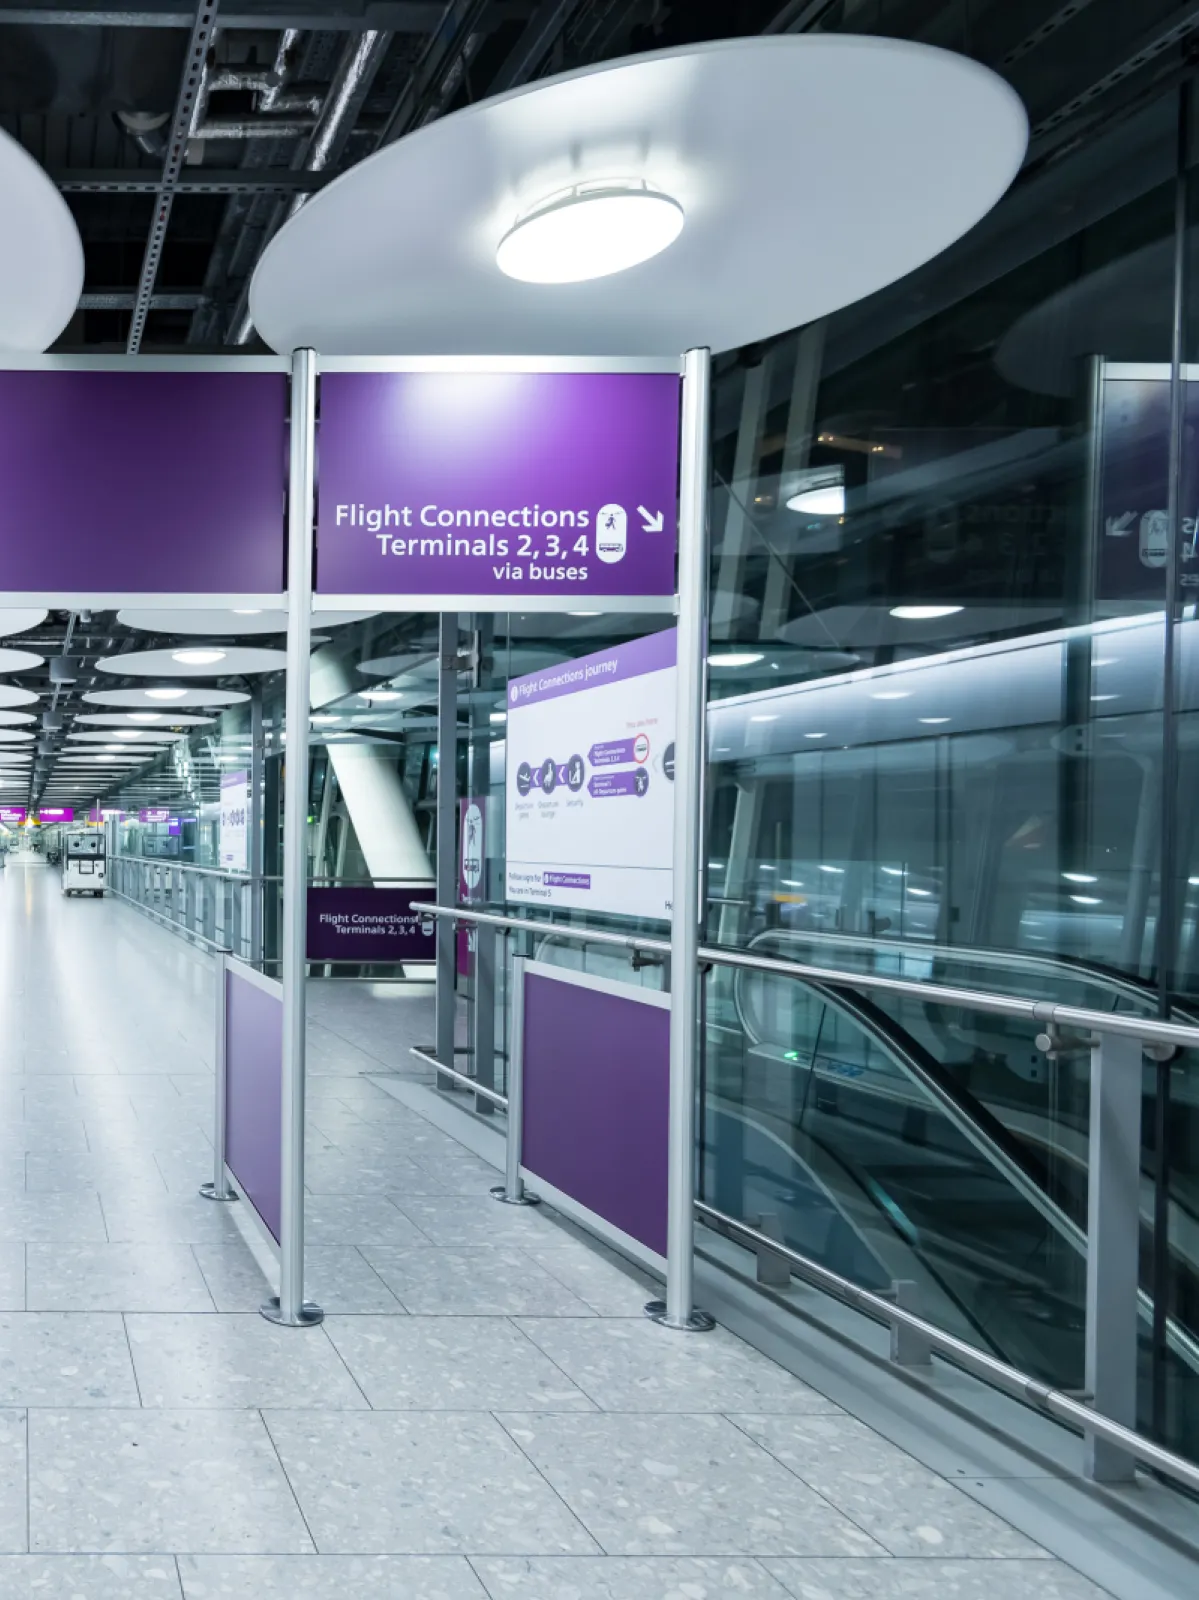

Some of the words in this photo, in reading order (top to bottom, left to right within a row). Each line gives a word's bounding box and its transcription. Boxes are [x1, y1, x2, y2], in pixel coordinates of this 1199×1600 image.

[336, 504, 413, 532] Flight
[420, 505, 589, 528] Connections
[376, 533, 509, 557] Terminals
[517, 535, 539, 559] 2,
[545, 535, 567, 560] 3,
[572, 535, 589, 557] 4
[493, 563, 523, 580] via
[530, 563, 588, 581] buses
[519, 680, 537, 698] Flight
[538, 668, 583, 691] Connections
[584, 659, 618, 681] journey
[319, 913, 350, 925] Flight
[351, 913, 414, 923] Connections
[335, 924, 386, 934] Terminals
[409, 925, 416, 934] 4
